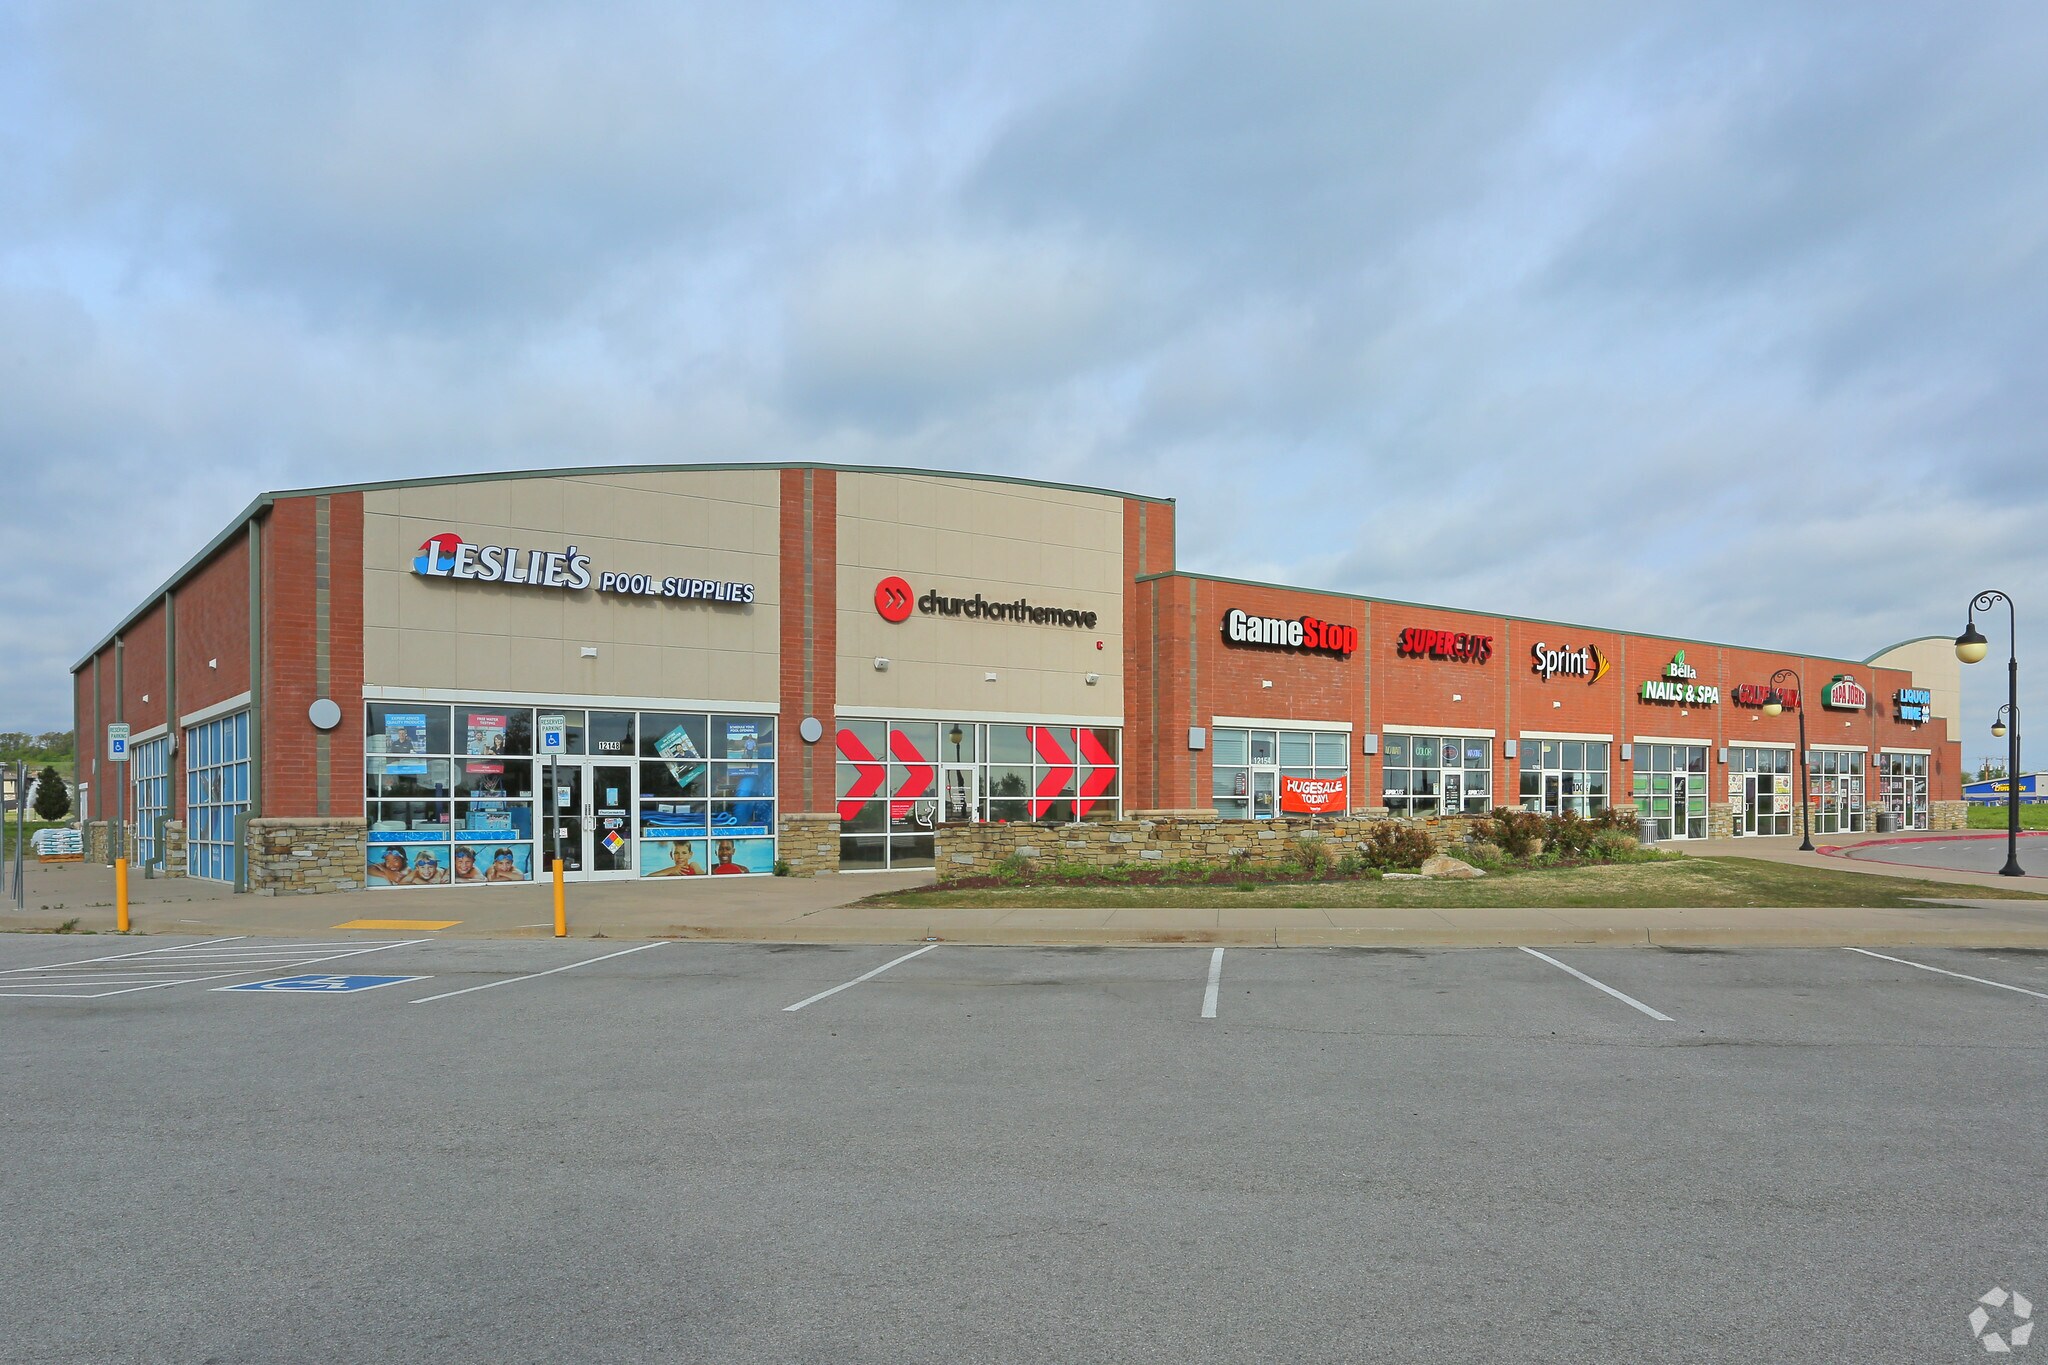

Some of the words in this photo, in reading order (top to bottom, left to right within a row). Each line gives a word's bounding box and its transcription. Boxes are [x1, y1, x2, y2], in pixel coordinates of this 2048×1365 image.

[426, 540, 591, 589] LESLIE'S
[602, 572, 655, 595] POOL
[663, 577, 755, 603] SUPPLIES
[918, 589, 1097, 628] churchonthemove
[1229, 609, 1358, 654] GameStop
[1403, 628, 1493, 660] SUPERCUTS
[1536, 642, 1589, 679] Sprint
[1645, 681, 1683, 702] NAILS
[1685, 685, 1695, 703] &
[1696, 685, 1719, 704] SPA
[1833, 685, 1847, 703] PAPA
[1901, 689, 1930, 704] LIQUOR
[1901, 705, 1921, 720] WINE
[600, 742, 620, 750] 12148
[1416, 747, 1432, 756] COLOR
[1301, 794, 1328, 804] TODAY!
